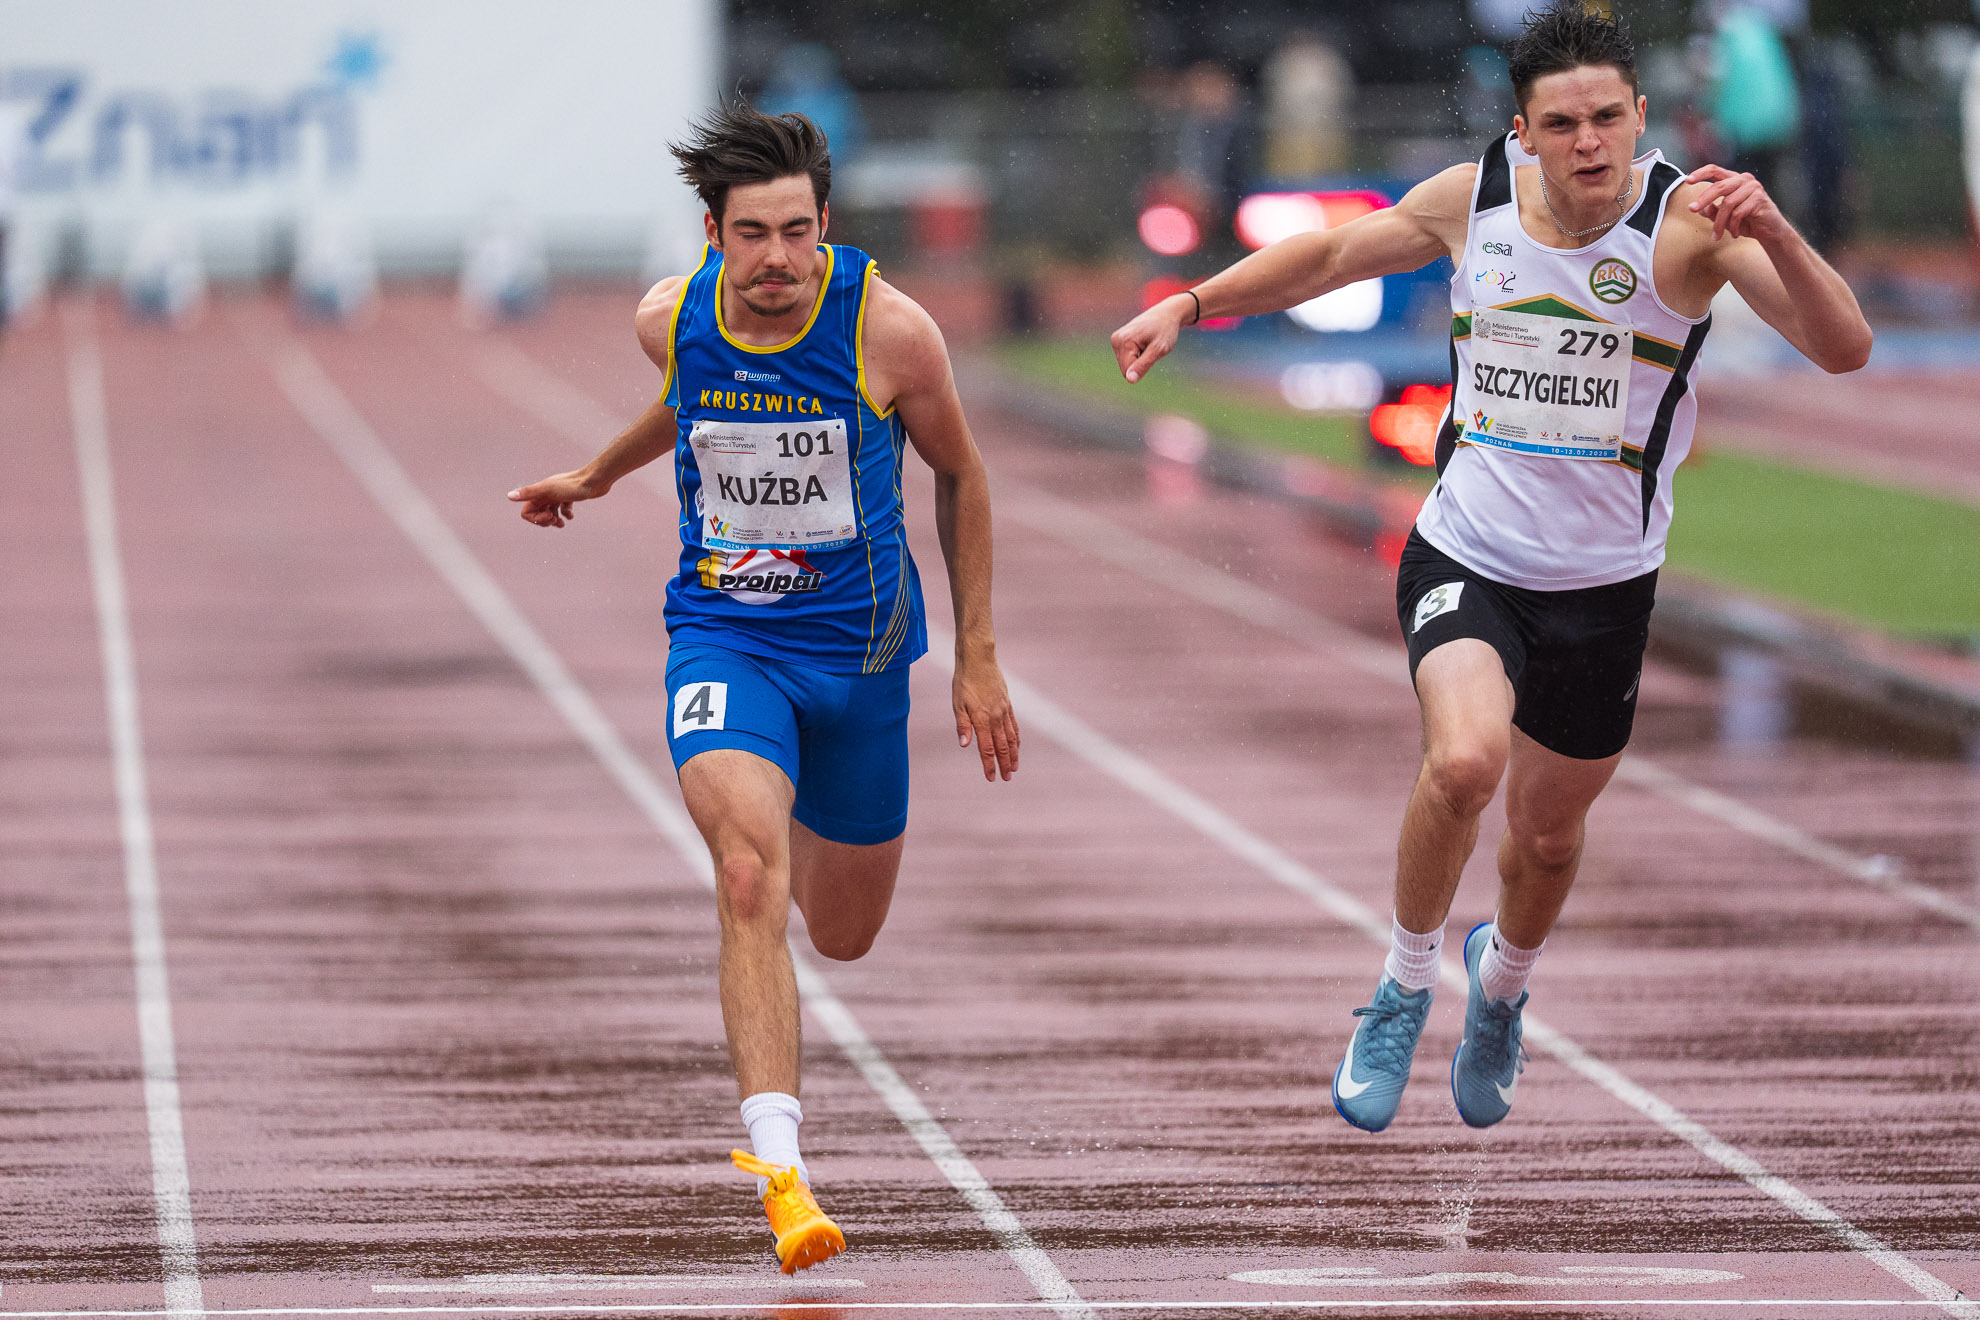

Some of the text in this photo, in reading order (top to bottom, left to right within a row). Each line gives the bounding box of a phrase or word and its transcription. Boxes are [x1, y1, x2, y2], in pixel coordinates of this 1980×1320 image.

[1597, 265, 1630, 282] RKS
[1491, 329, 1510, 339] Sportu
[1514, 332, 1540, 343] Turystyki
[1492, 322, 1529, 333] Ministerstwo
[1557, 328, 1619, 359] 279
[1474, 362, 1619, 409] SZCZYGIELSKI
[700, 389, 824, 415] KRUSZWICA
[709, 434, 745, 442] Ministerstwo
[775, 430, 834, 458] 101
[717, 471, 829, 506] KUŹBA
[718, 571, 822, 594] Projpal
[1421, 587, 1448, 620] 3
[681, 685, 715, 726] 4
